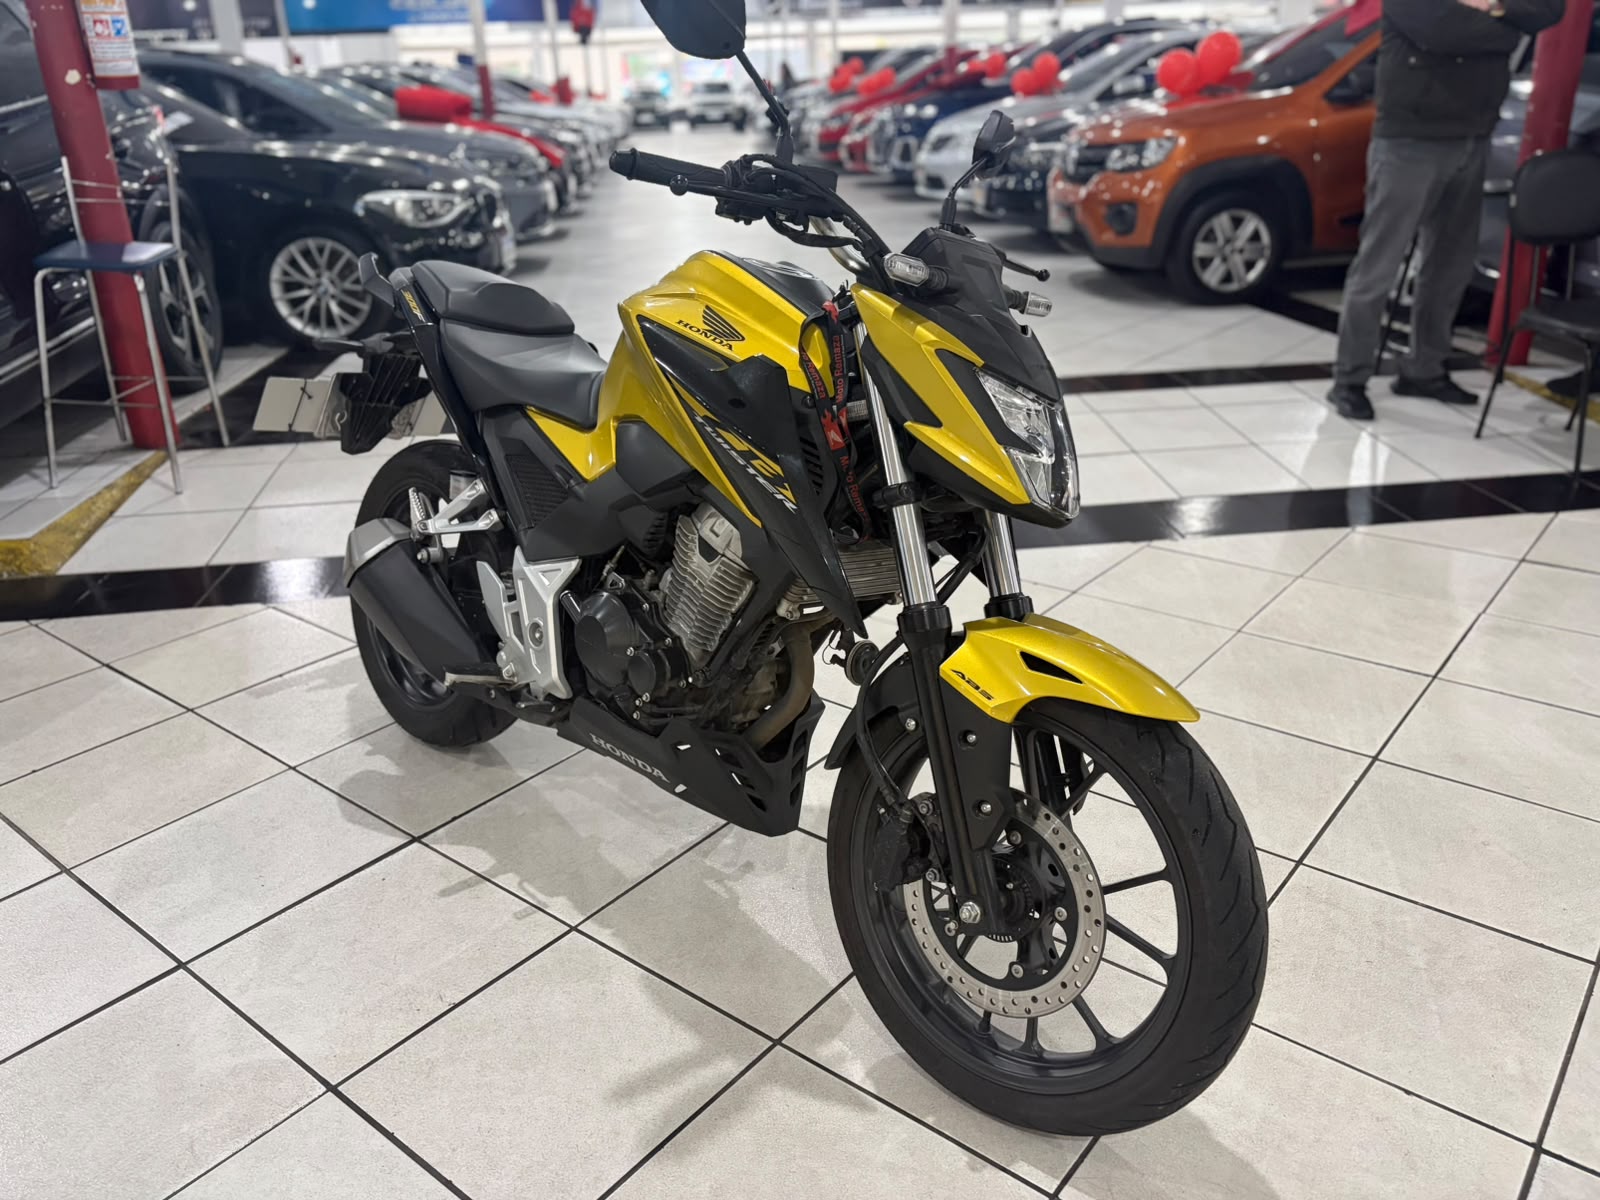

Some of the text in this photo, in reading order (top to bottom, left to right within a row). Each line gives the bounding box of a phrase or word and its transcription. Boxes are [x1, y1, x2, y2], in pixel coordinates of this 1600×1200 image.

[676, 319, 733, 351] HONDA
[950, 669, 995, 701] ABS
[589, 732, 671, 783] HONDA
